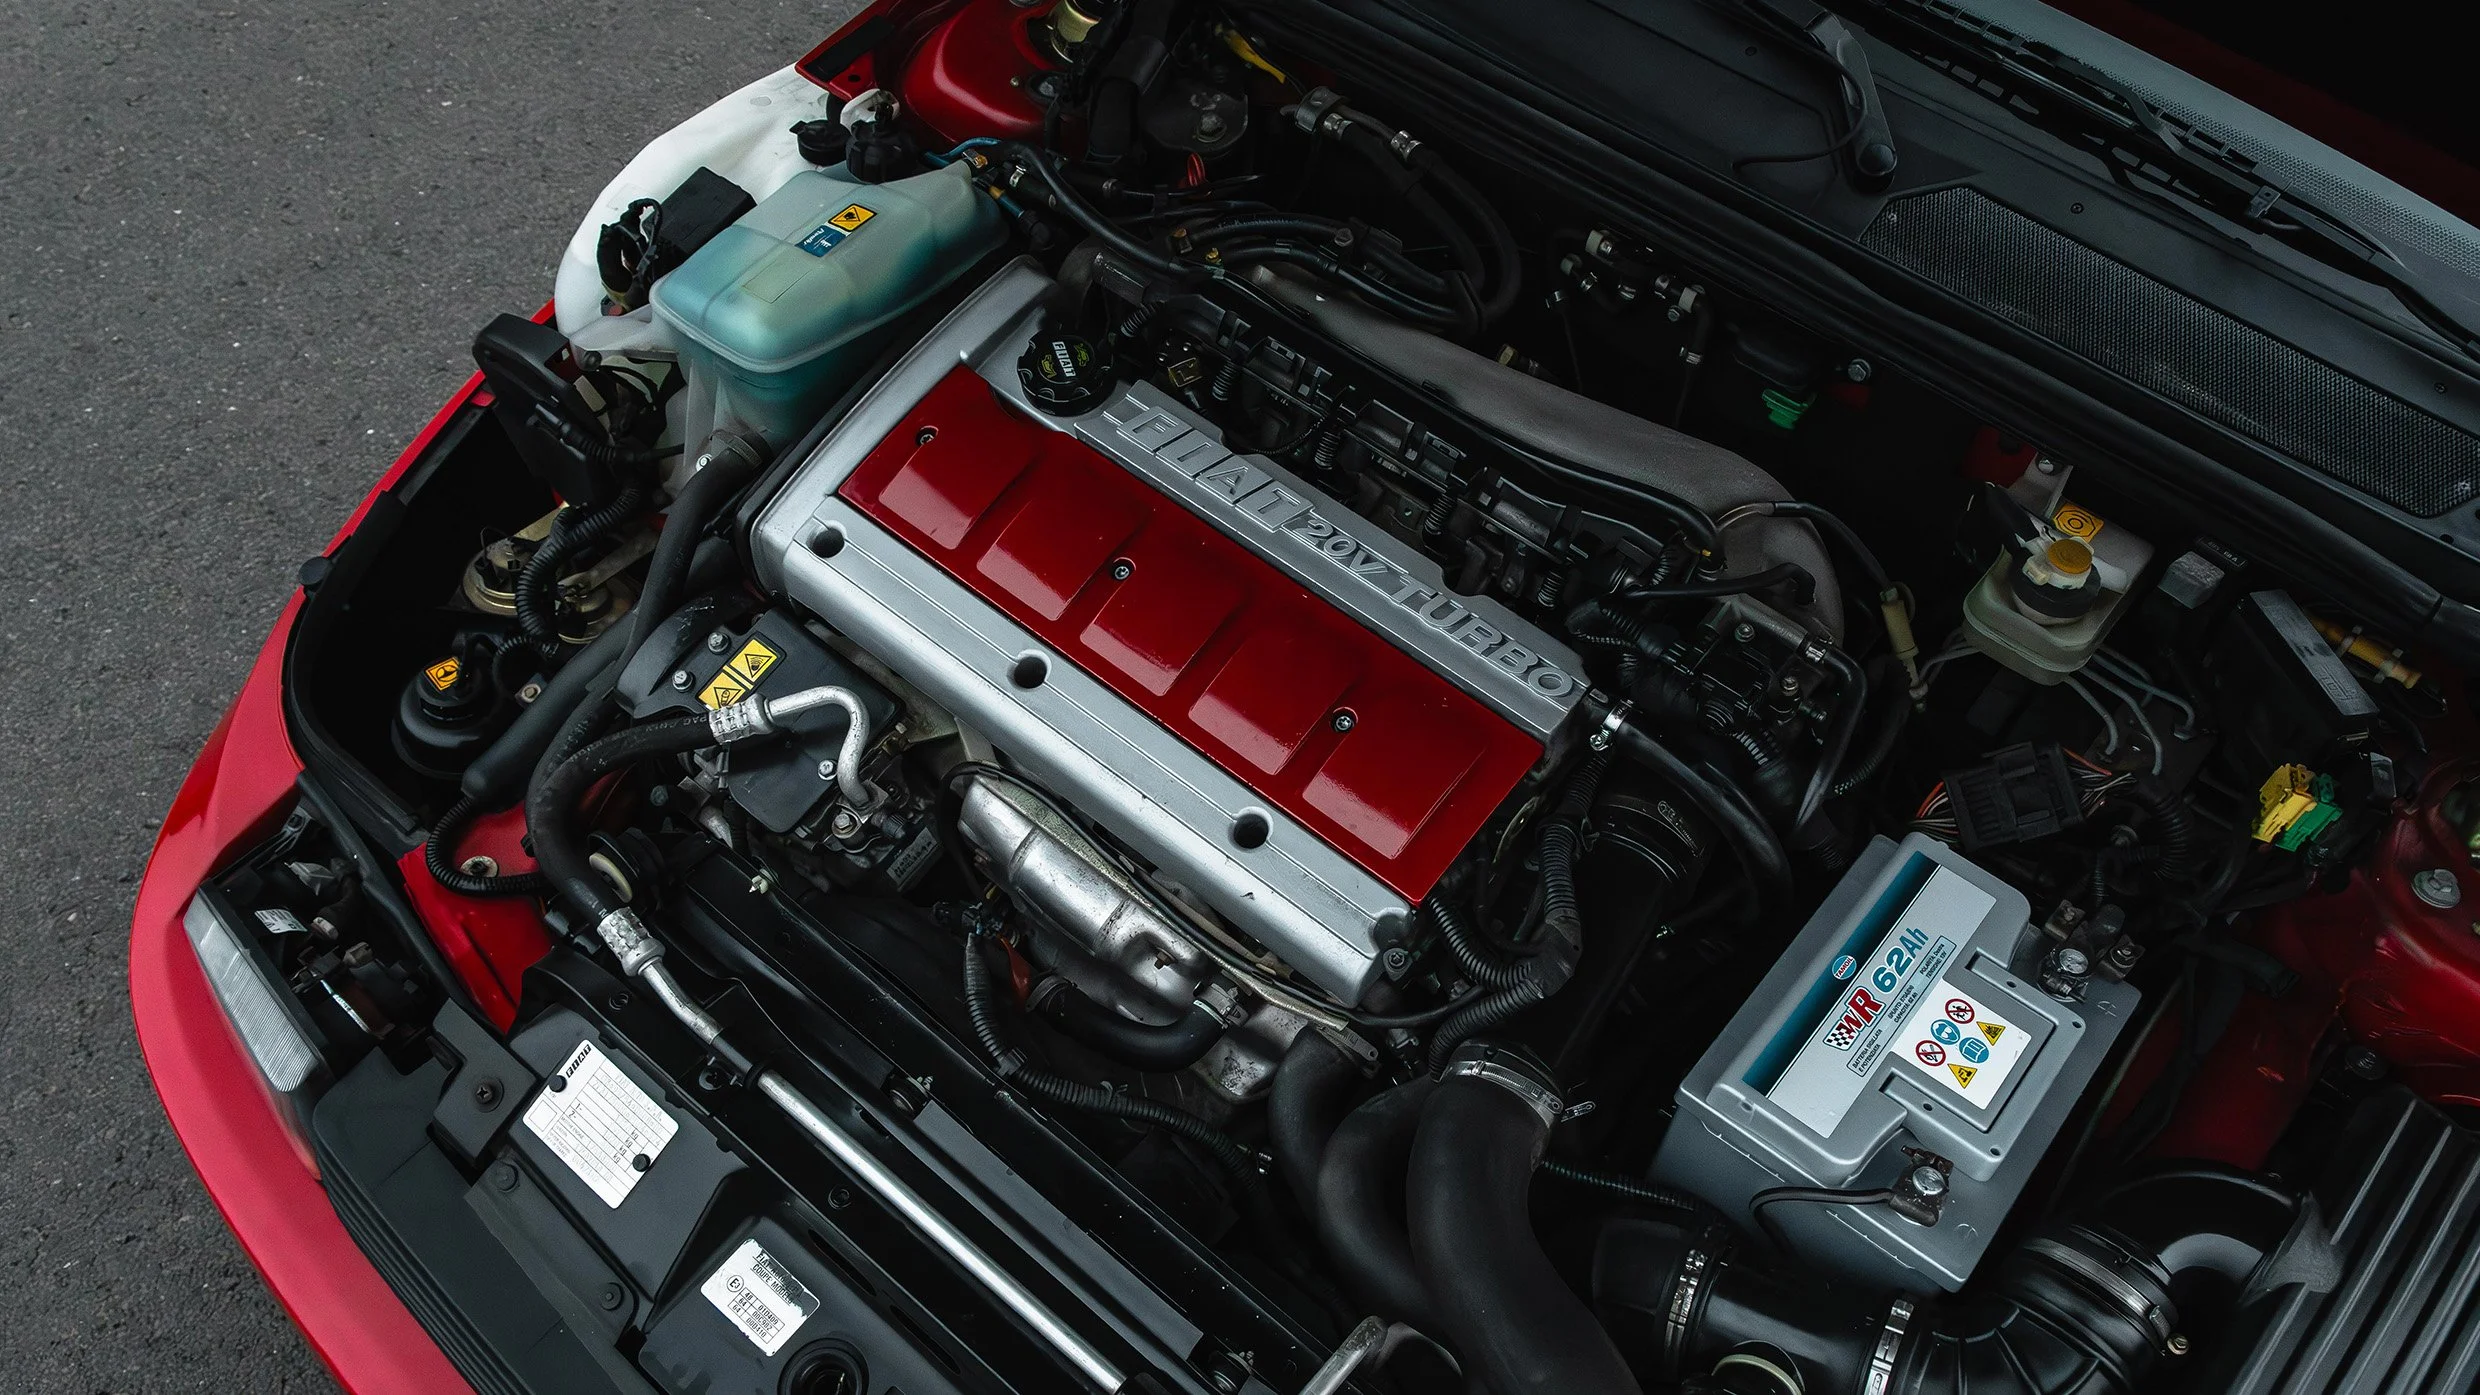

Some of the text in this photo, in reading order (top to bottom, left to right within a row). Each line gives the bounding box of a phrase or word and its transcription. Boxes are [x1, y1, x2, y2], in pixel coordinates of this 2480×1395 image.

[1052, 341, 1076, 377] FIAT
[1125, 408, 1576, 699] FIAT 20V TURBO
[1835, 955, 1855, 979] TAMOIL
[565, 1044, 592, 1079] FIAT
[624, 1137, 634, 1149] kg
[629, 1129, 640, 1141] kg
[612, 1153, 622, 1165] kg
[618, 1146, 628, 1157] kg
